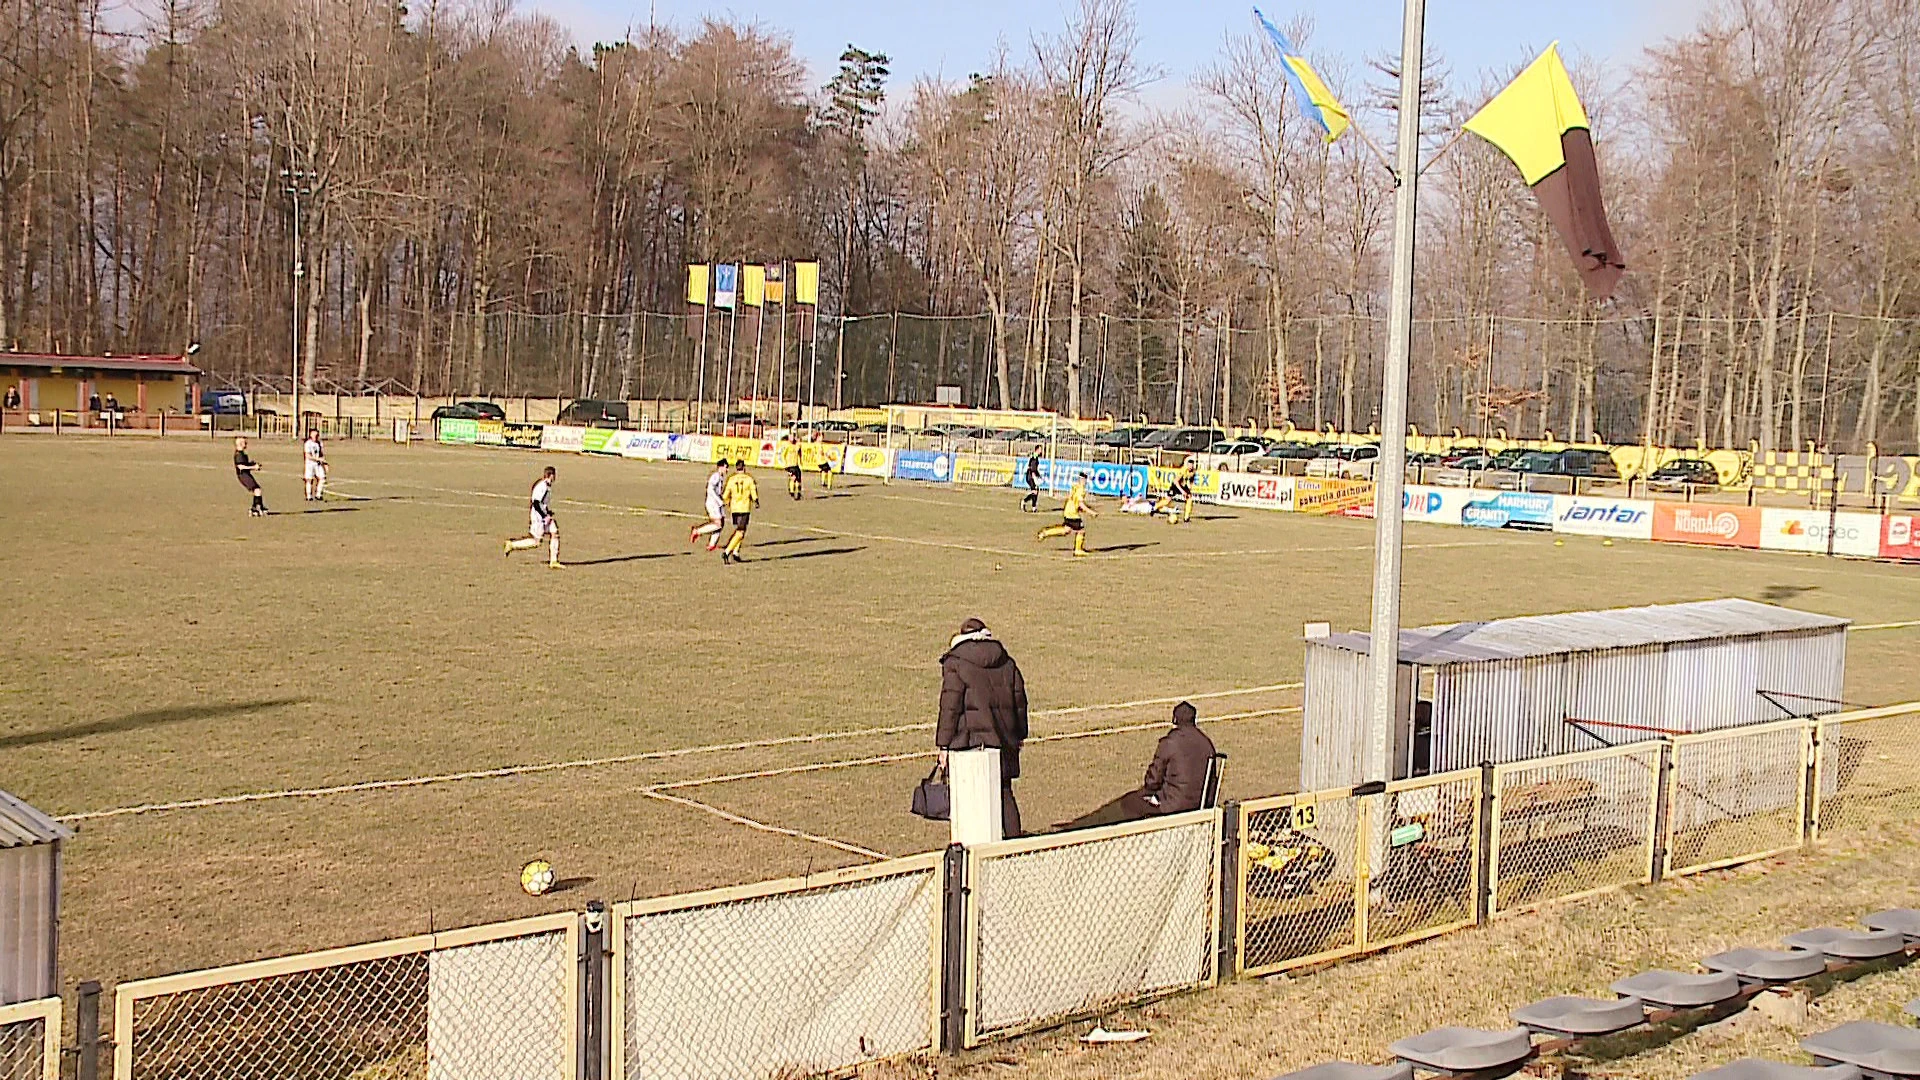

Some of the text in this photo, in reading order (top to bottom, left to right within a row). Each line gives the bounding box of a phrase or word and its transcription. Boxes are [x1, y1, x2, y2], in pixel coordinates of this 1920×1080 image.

[1220, 479, 1292, 504] gwe24.pl
[1499, 496, 1549, 513] MARMURY
[1560, 500, 1647, 523] jantar
[1808, 525, 1859, 542] opec
[1296, 806, 1315, 826] 13
